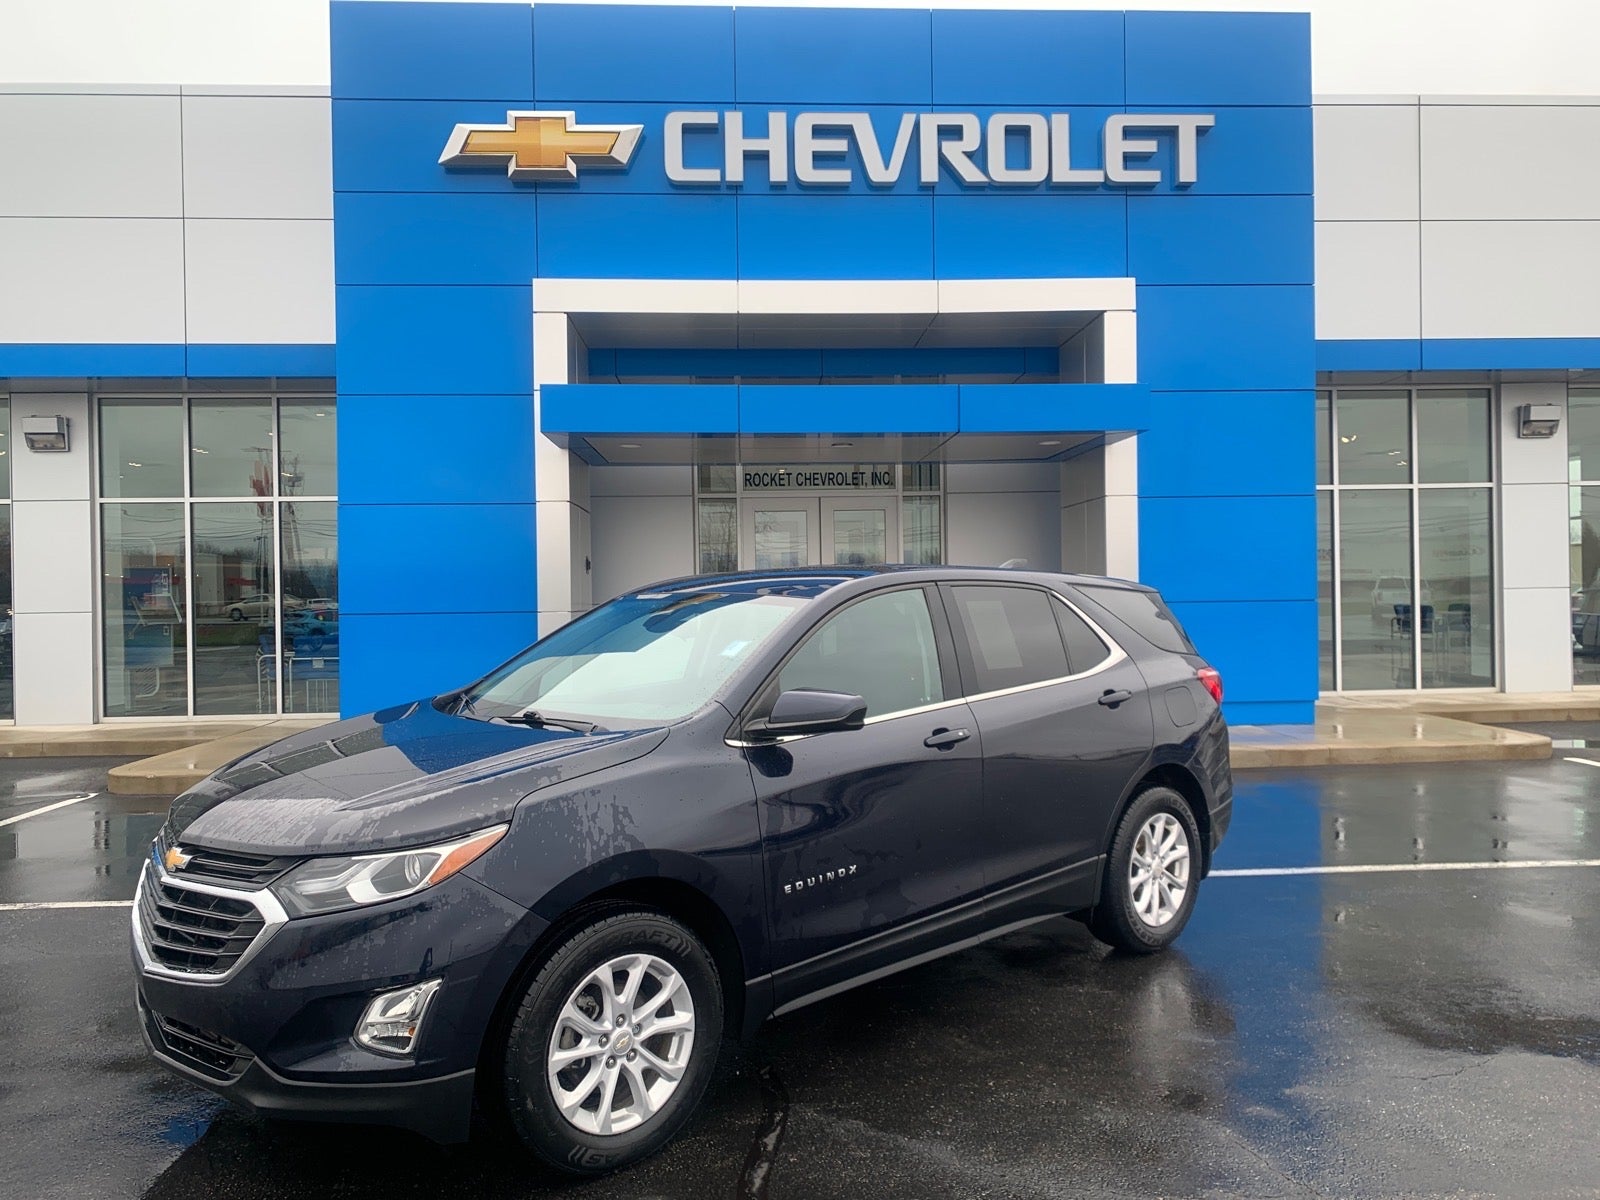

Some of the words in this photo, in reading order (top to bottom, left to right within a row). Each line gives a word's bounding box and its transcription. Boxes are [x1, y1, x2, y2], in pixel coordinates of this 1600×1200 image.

[663, 111, 1216, 188] CHEVROLET
[744, 472, 793, 487] ROCKET
[795, 471, 868, 488] CHEVROLET,
[871, 471, 894, 486] INC.
[783, 864, 858, 895] EQUINOX
